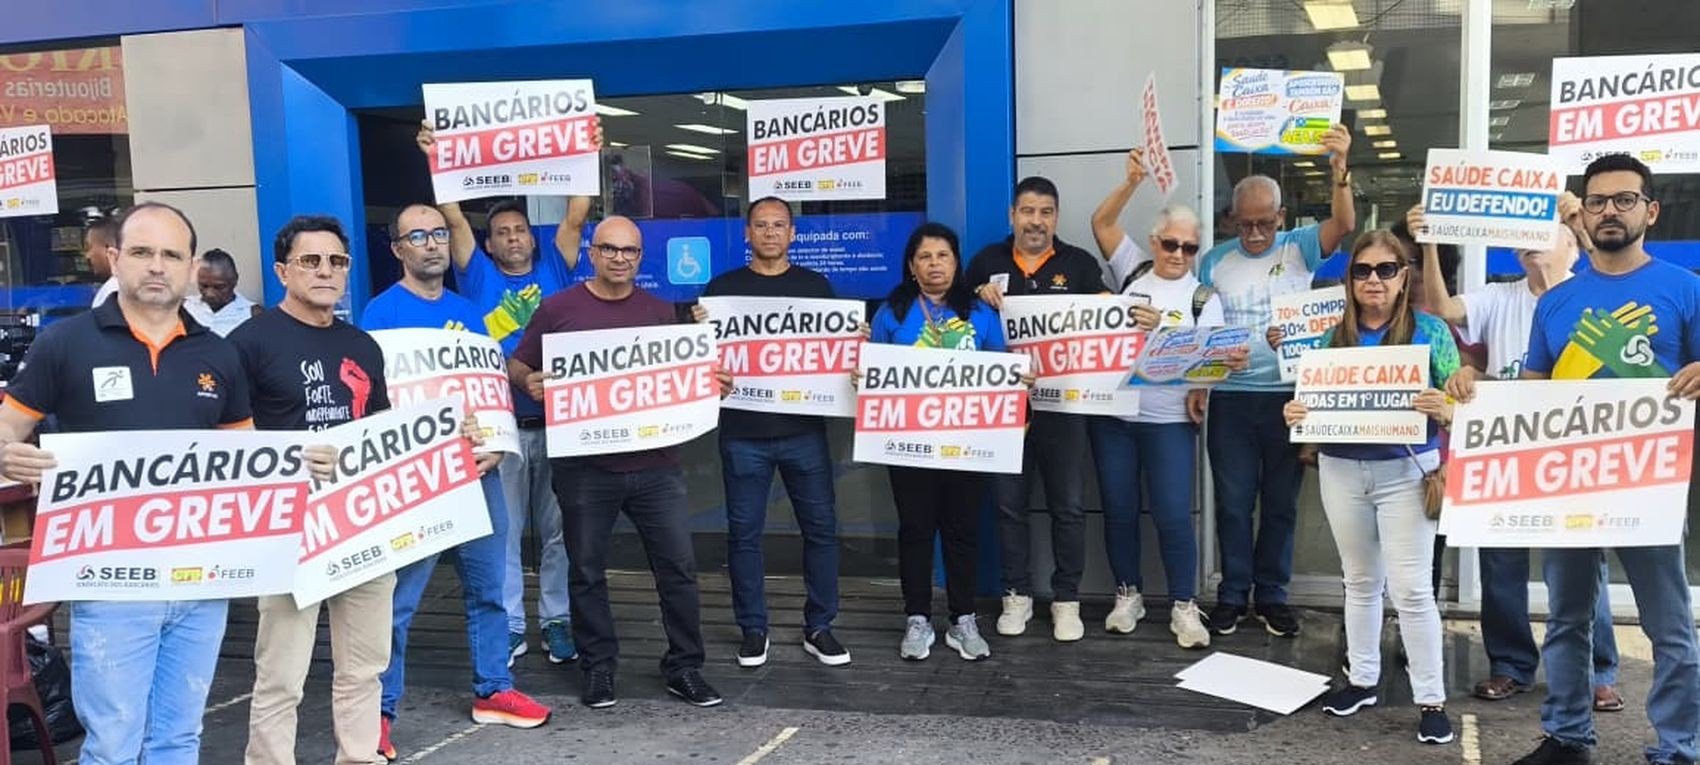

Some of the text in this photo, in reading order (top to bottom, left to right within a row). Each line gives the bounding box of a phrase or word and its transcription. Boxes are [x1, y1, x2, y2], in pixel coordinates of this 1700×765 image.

[434, 89, 588, 130] BANCÁRIOS
[753, 103, 879, 140] BANCÁRIOS
[1556, 108, 1604, 142] EM
[436, 120, 589, 169] EM GREVE
[753, 130, 879, 174] EM GREVE
[1430, 160, 1559, 190] SAÚDE CAIXA
[1430, 192, 1549, 217] EU DEFENDO!
[1007, 302, 1138, 340] BANCÁRIOS
[1277, 307, 1300, 320] 70%
[301, 360, 324, 384] SOU
[550, 334, 709, 380] BANCÁRIOS
[759, 340, 857, 373] GREVE
[865, 357, 1021, 389] BANCÁRIOS
[1048, 336, 1137, 373] GREVE
[1302, 362, 1422, 386] SAÚDE CAIXA
[553, 367, 712, 422] EM GREVE
[863, 394, 1018, 429] EM GREVE
[1337, 392, 1357, 408] EM
[1465, 395, 1682, 449] BANCÁRIOS
[308, 407, 456, 494] CÁRIOS
[1461, 435, 1679, 500] EM GREVE
[51, 442, 304, 503] BANCÁRIOS
[300, 443, 467, 554] M GREVE
[42, 487, 298, 557] EM GREVE
[1508, 515, 1553, 527] SEEB
[100, 567, 156, 580] SEEB
[221, 568, 254, 579] FEEB
[341, 545, 382, 570] SEEB
